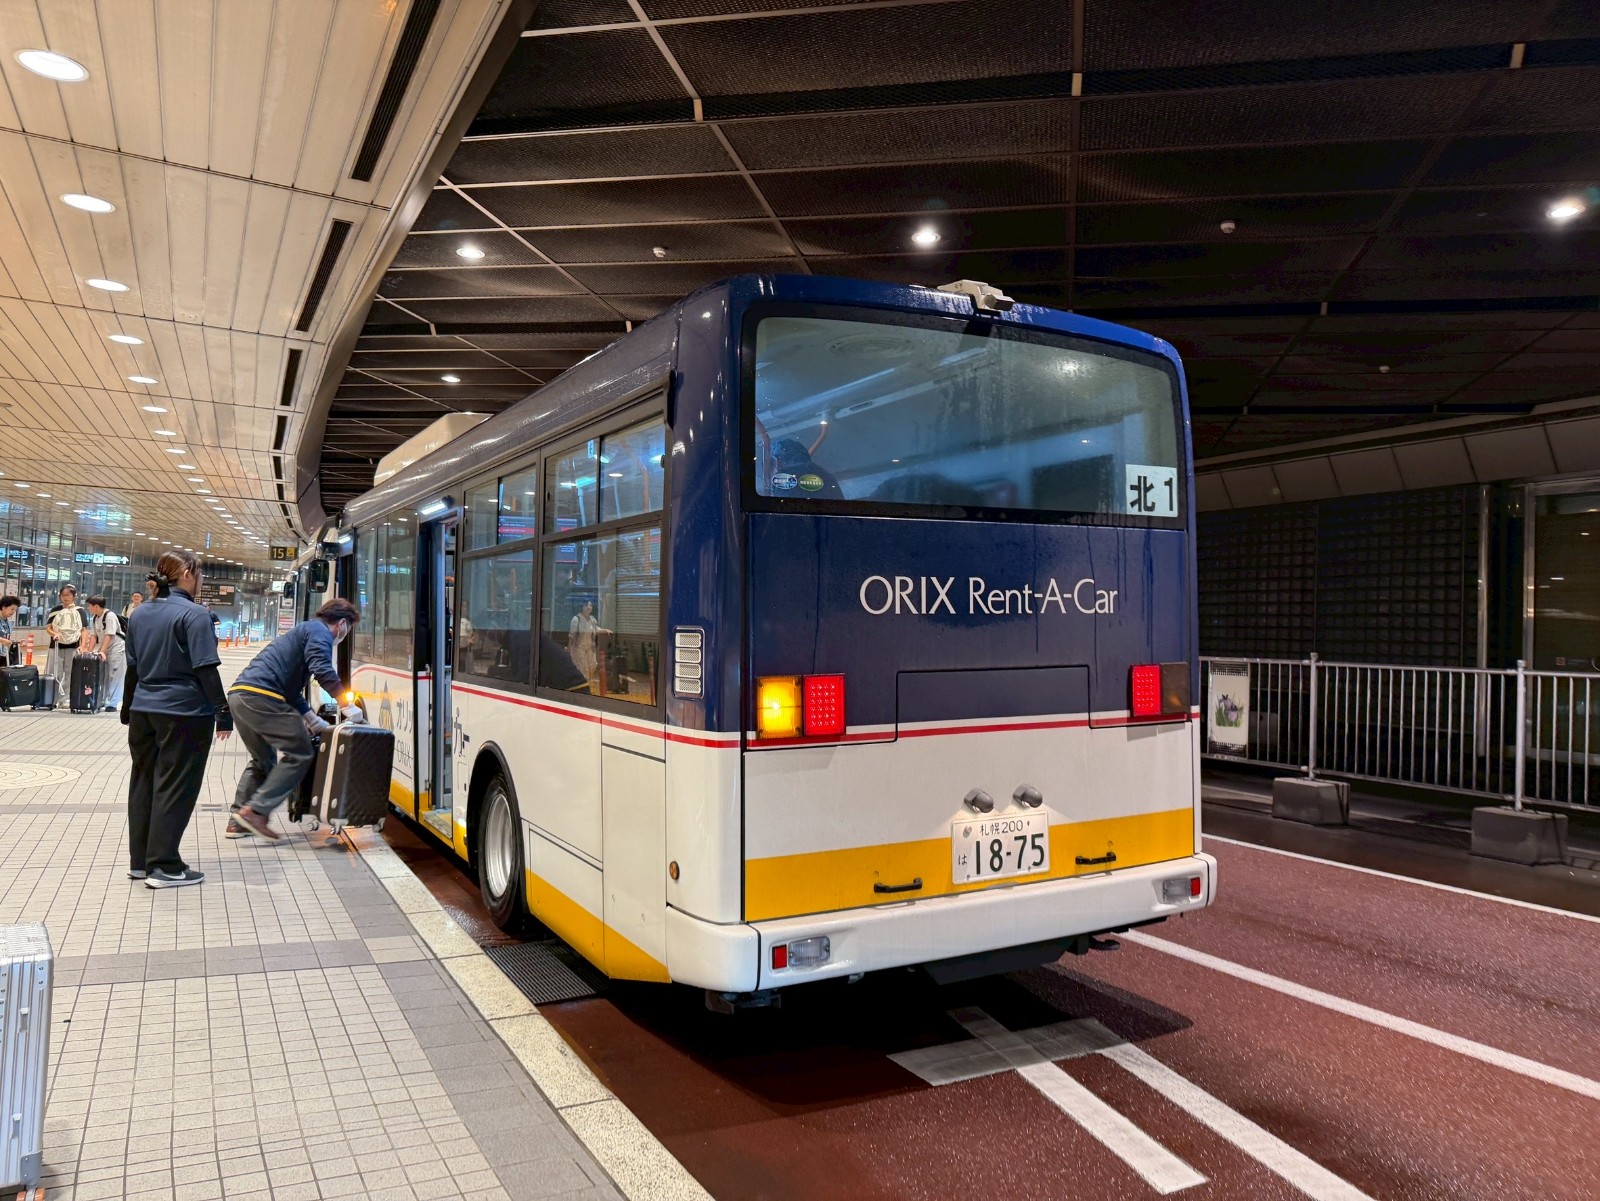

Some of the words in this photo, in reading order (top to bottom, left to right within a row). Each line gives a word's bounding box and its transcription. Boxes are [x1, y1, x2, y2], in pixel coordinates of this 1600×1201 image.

[272, 548, 285, 559] 15
[859, 575, 956, 616] ORIX
[969, 576, 1118, 616] Rent-A-Car
[958, 854, 968, 865] は
[975, 832, 1045, 876] 18-75
